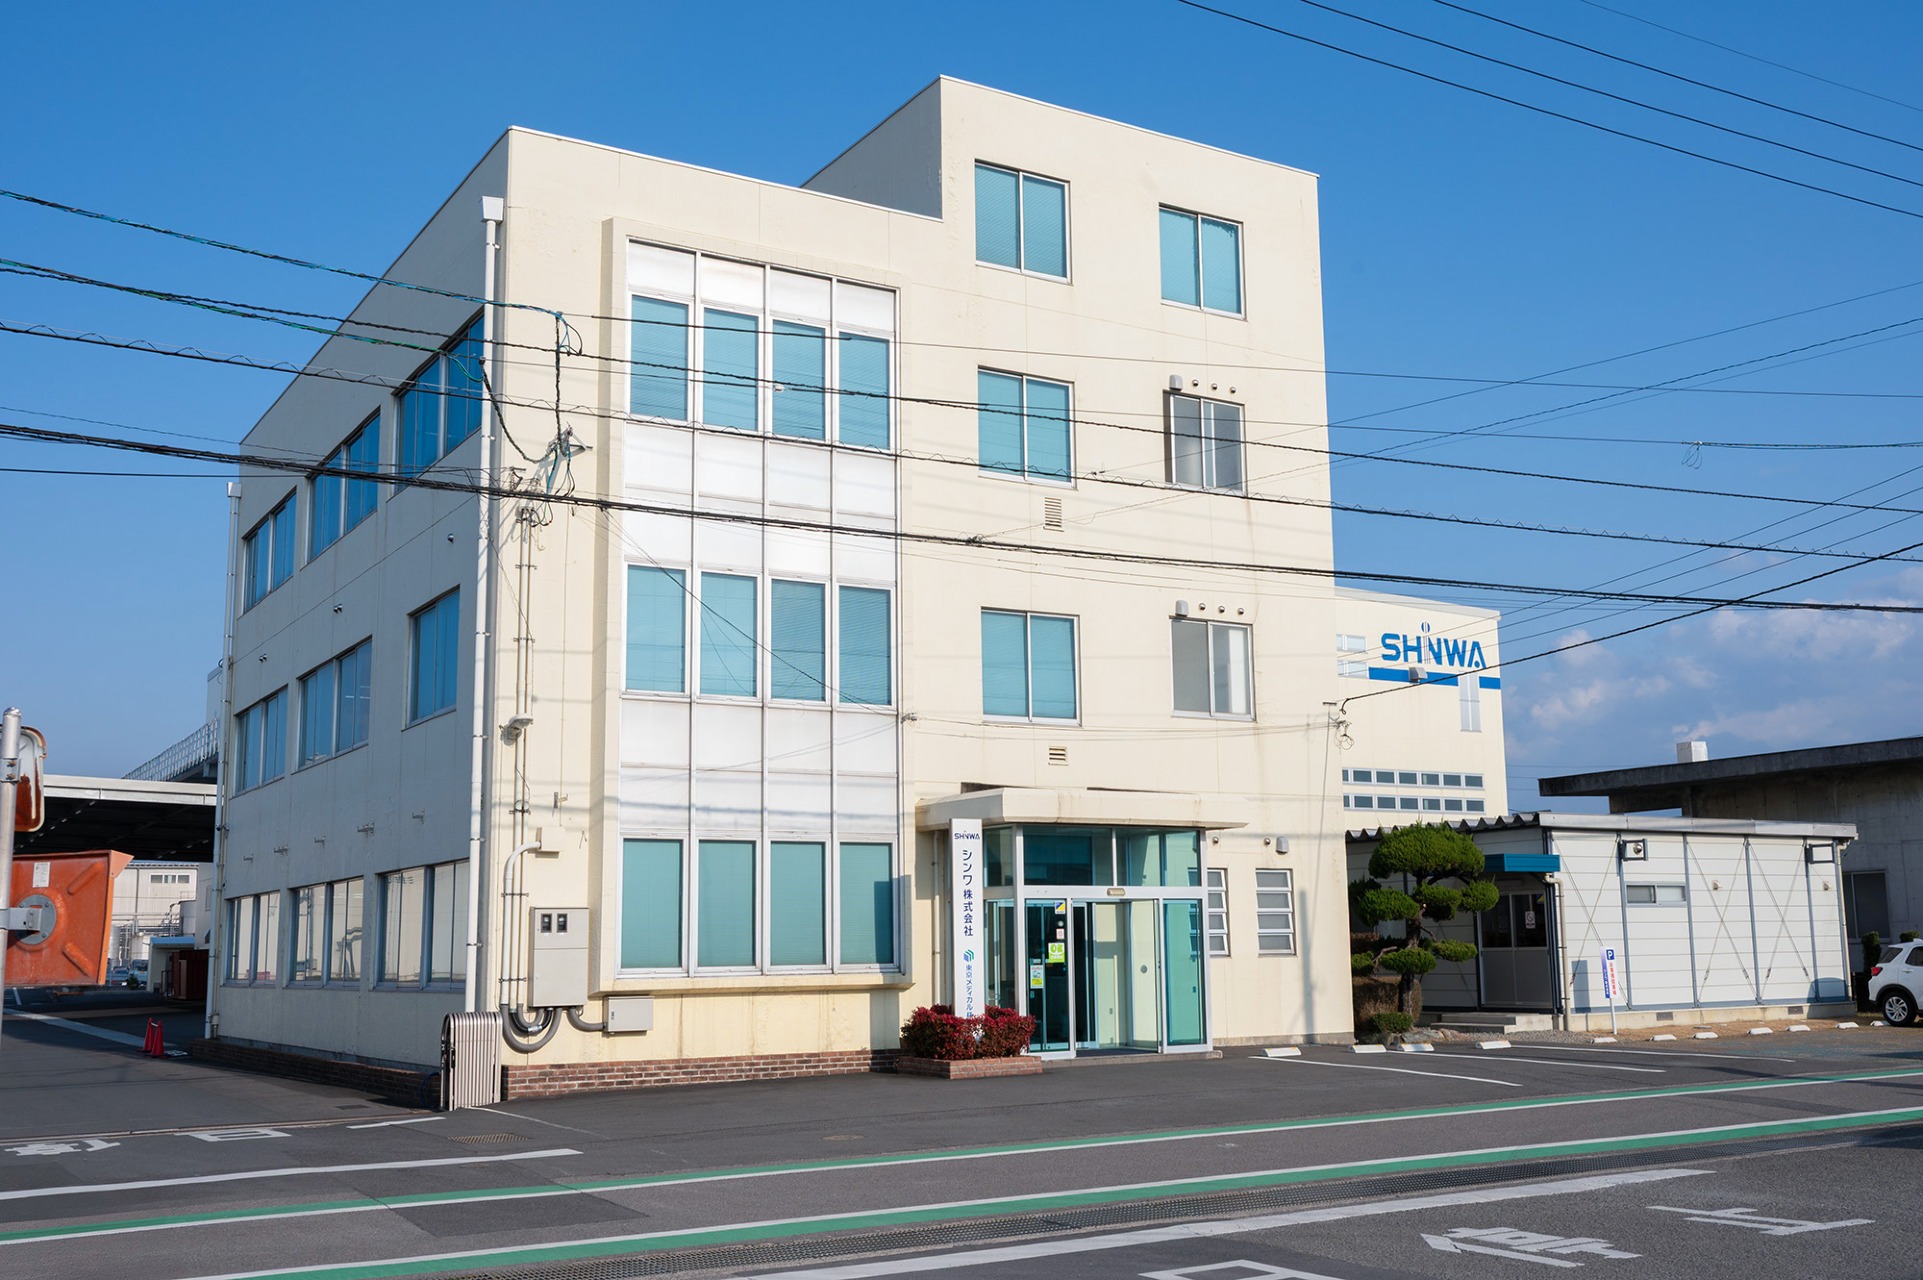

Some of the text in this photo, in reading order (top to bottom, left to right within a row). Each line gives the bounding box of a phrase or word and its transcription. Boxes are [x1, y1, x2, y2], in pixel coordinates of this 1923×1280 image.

[963, 850, 973, 937] シンワ株式会社
